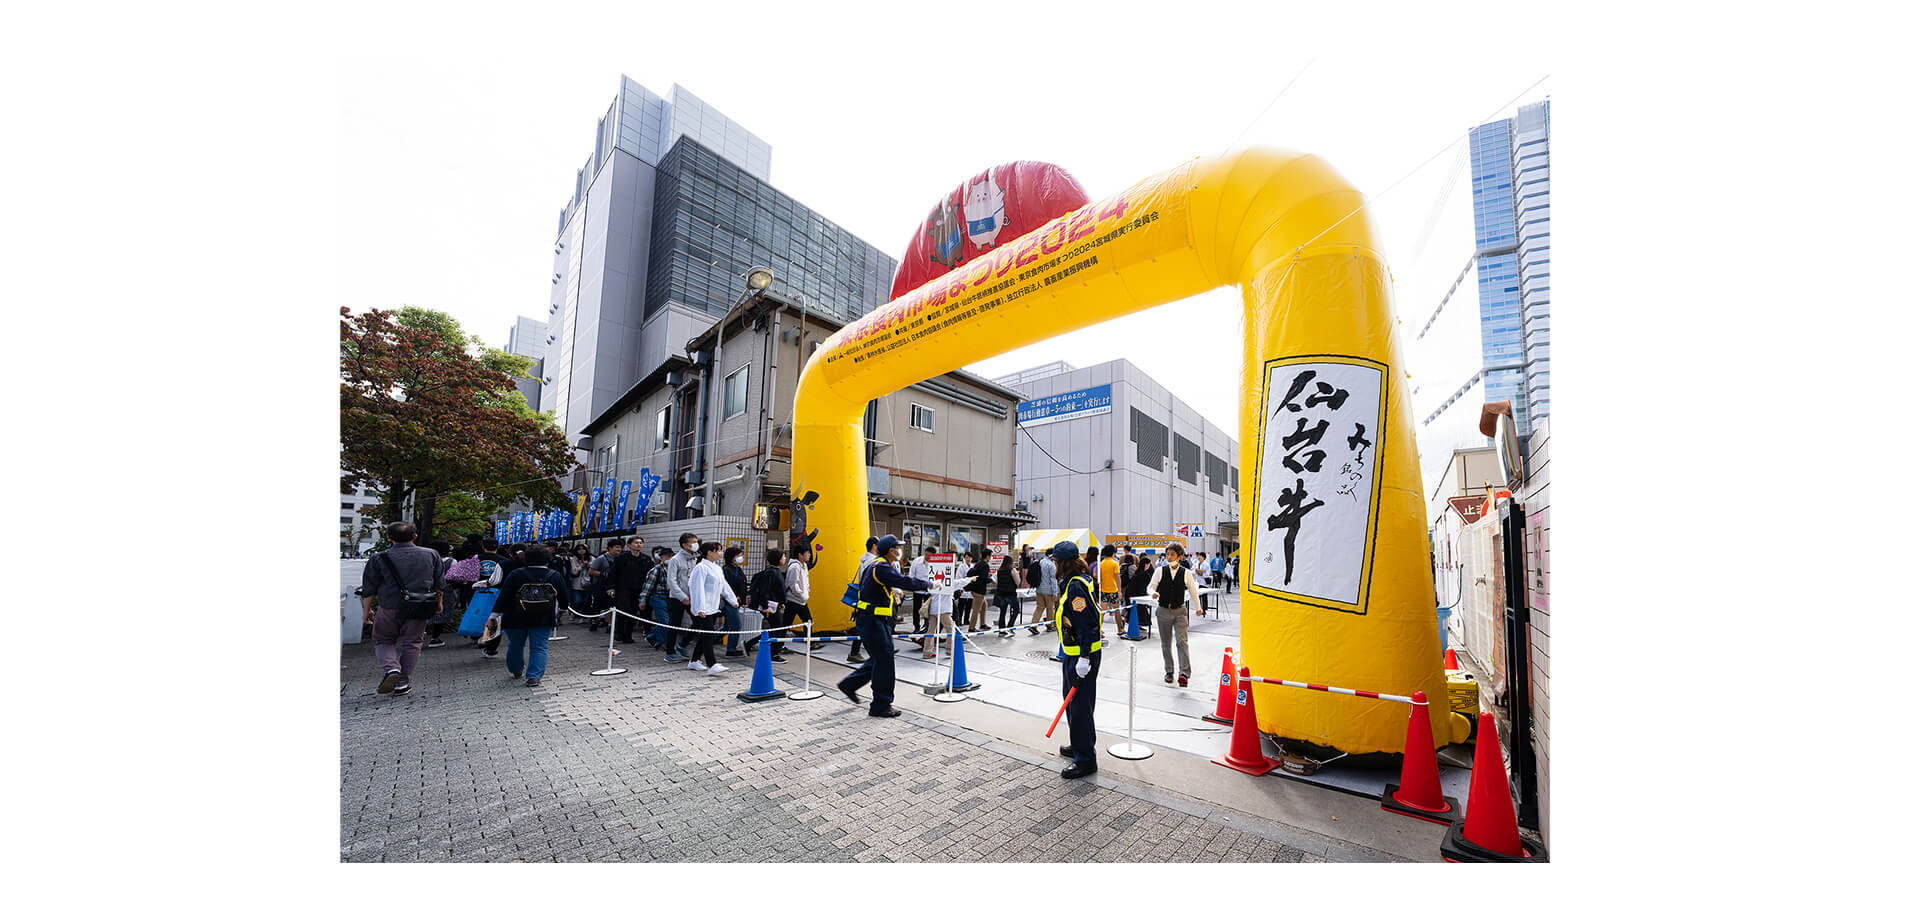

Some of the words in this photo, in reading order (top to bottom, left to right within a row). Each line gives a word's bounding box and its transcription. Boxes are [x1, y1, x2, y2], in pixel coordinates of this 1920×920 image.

[1267, 370, 1350, 585] 仙台牛
[945, 565, 952, 587] 出口
